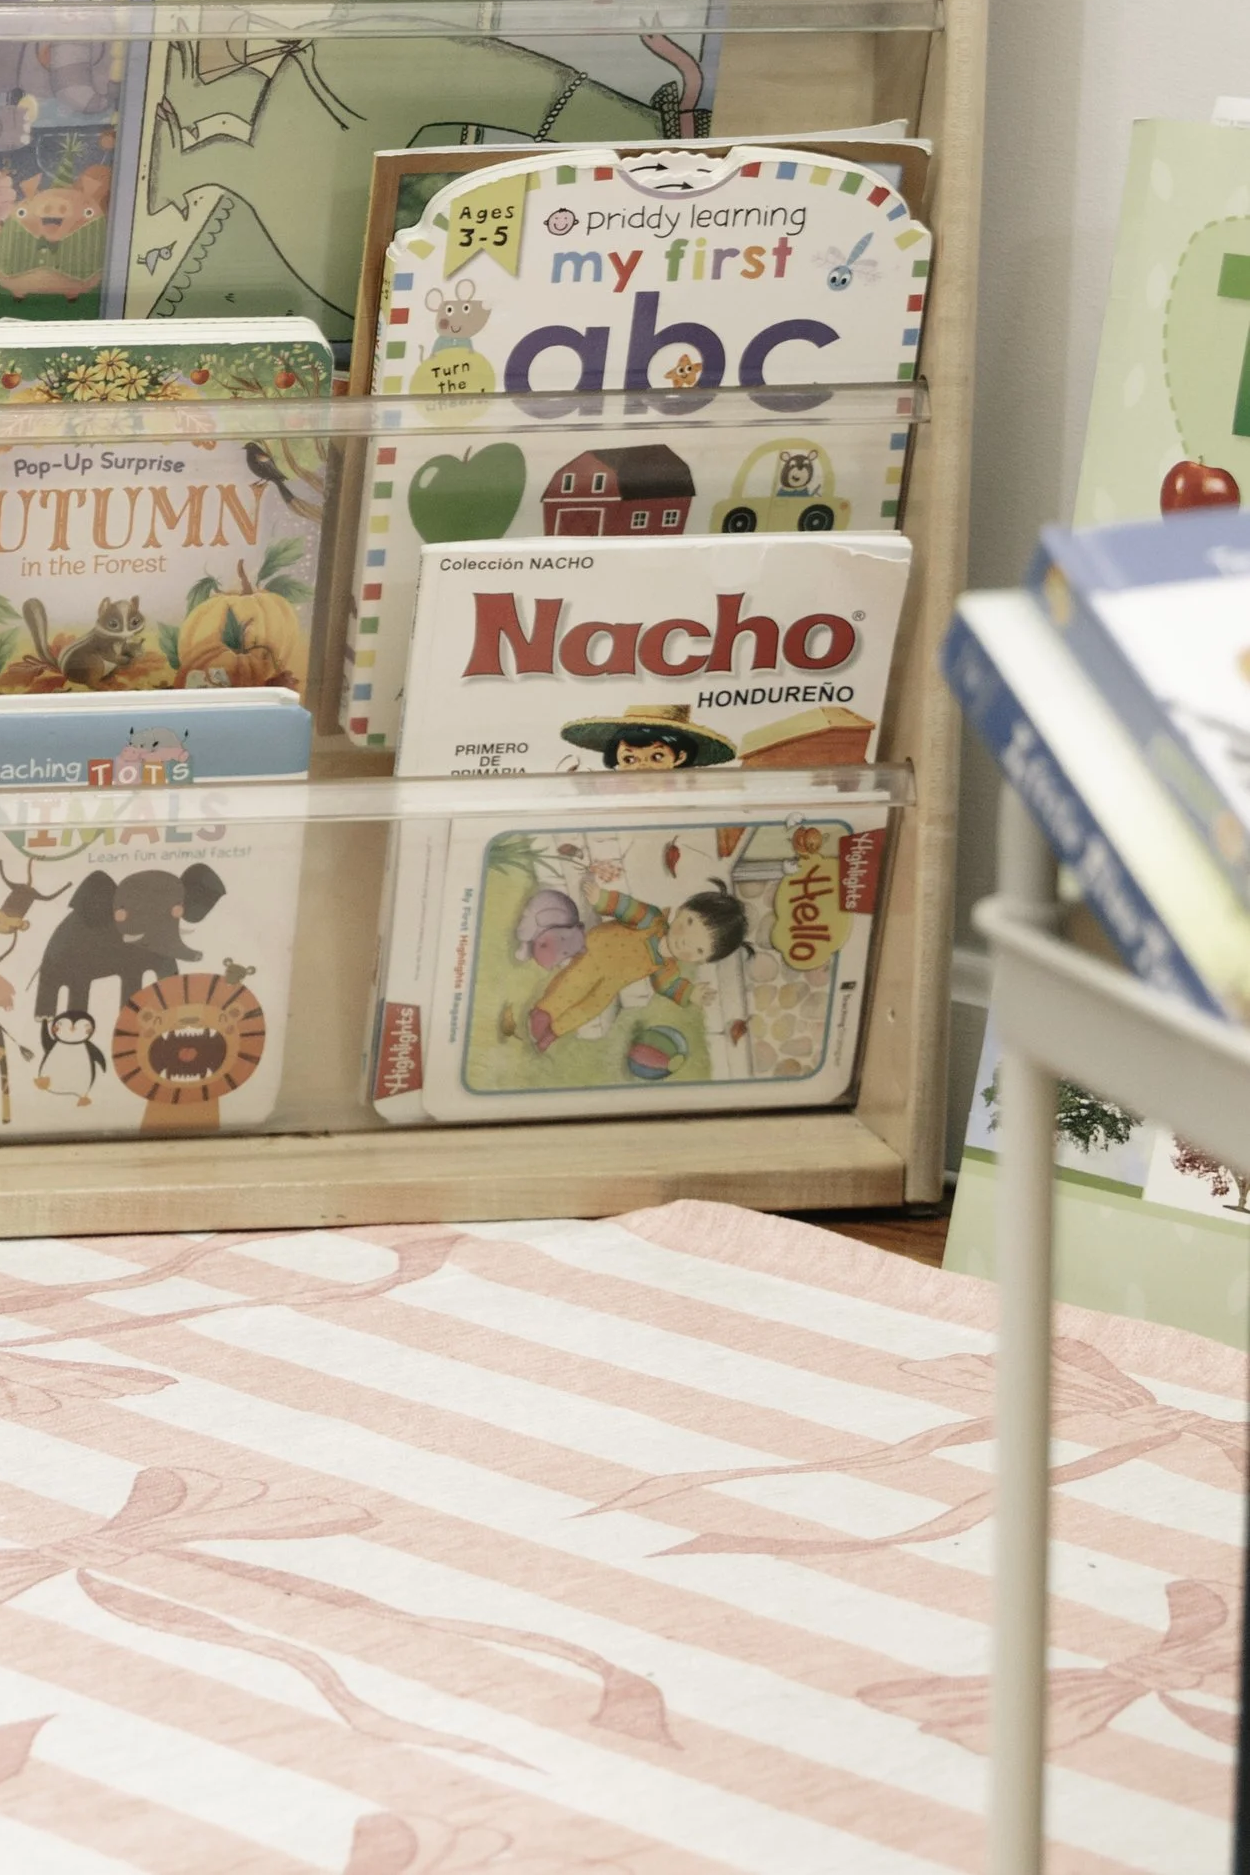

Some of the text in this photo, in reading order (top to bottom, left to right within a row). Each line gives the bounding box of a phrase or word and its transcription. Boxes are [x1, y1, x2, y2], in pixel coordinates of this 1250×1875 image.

[459, 203, 515, 222] Ages
[586, 203, 808, 239] priddy learning
[458, 226, 510, 248] 3-5
[551, 237, 792, 293] my first
[502, 291, 841, 419] abc
[432, 359, 471, 380] Turn
[438, 378, 467, 393] the
[14, 451, 186, 477] Pop-Up Surprise
[20, 552, 168, 577] in the Forest
[439, 555, 594, 572] Colección NACHO
[461, 592, 856, 680] Nacho
[698, 683, 855, 709] HONDUREÑO
[454, 741, 529, 757] PRIMERO
[479, 755, 505, 768] DE
[845, 832, 874, 910] Highlights
[789, 863, 834, 961] Hello
[454, 935, 468, 989] Highlights
[384, 1007, 418, 1095] Highlights
